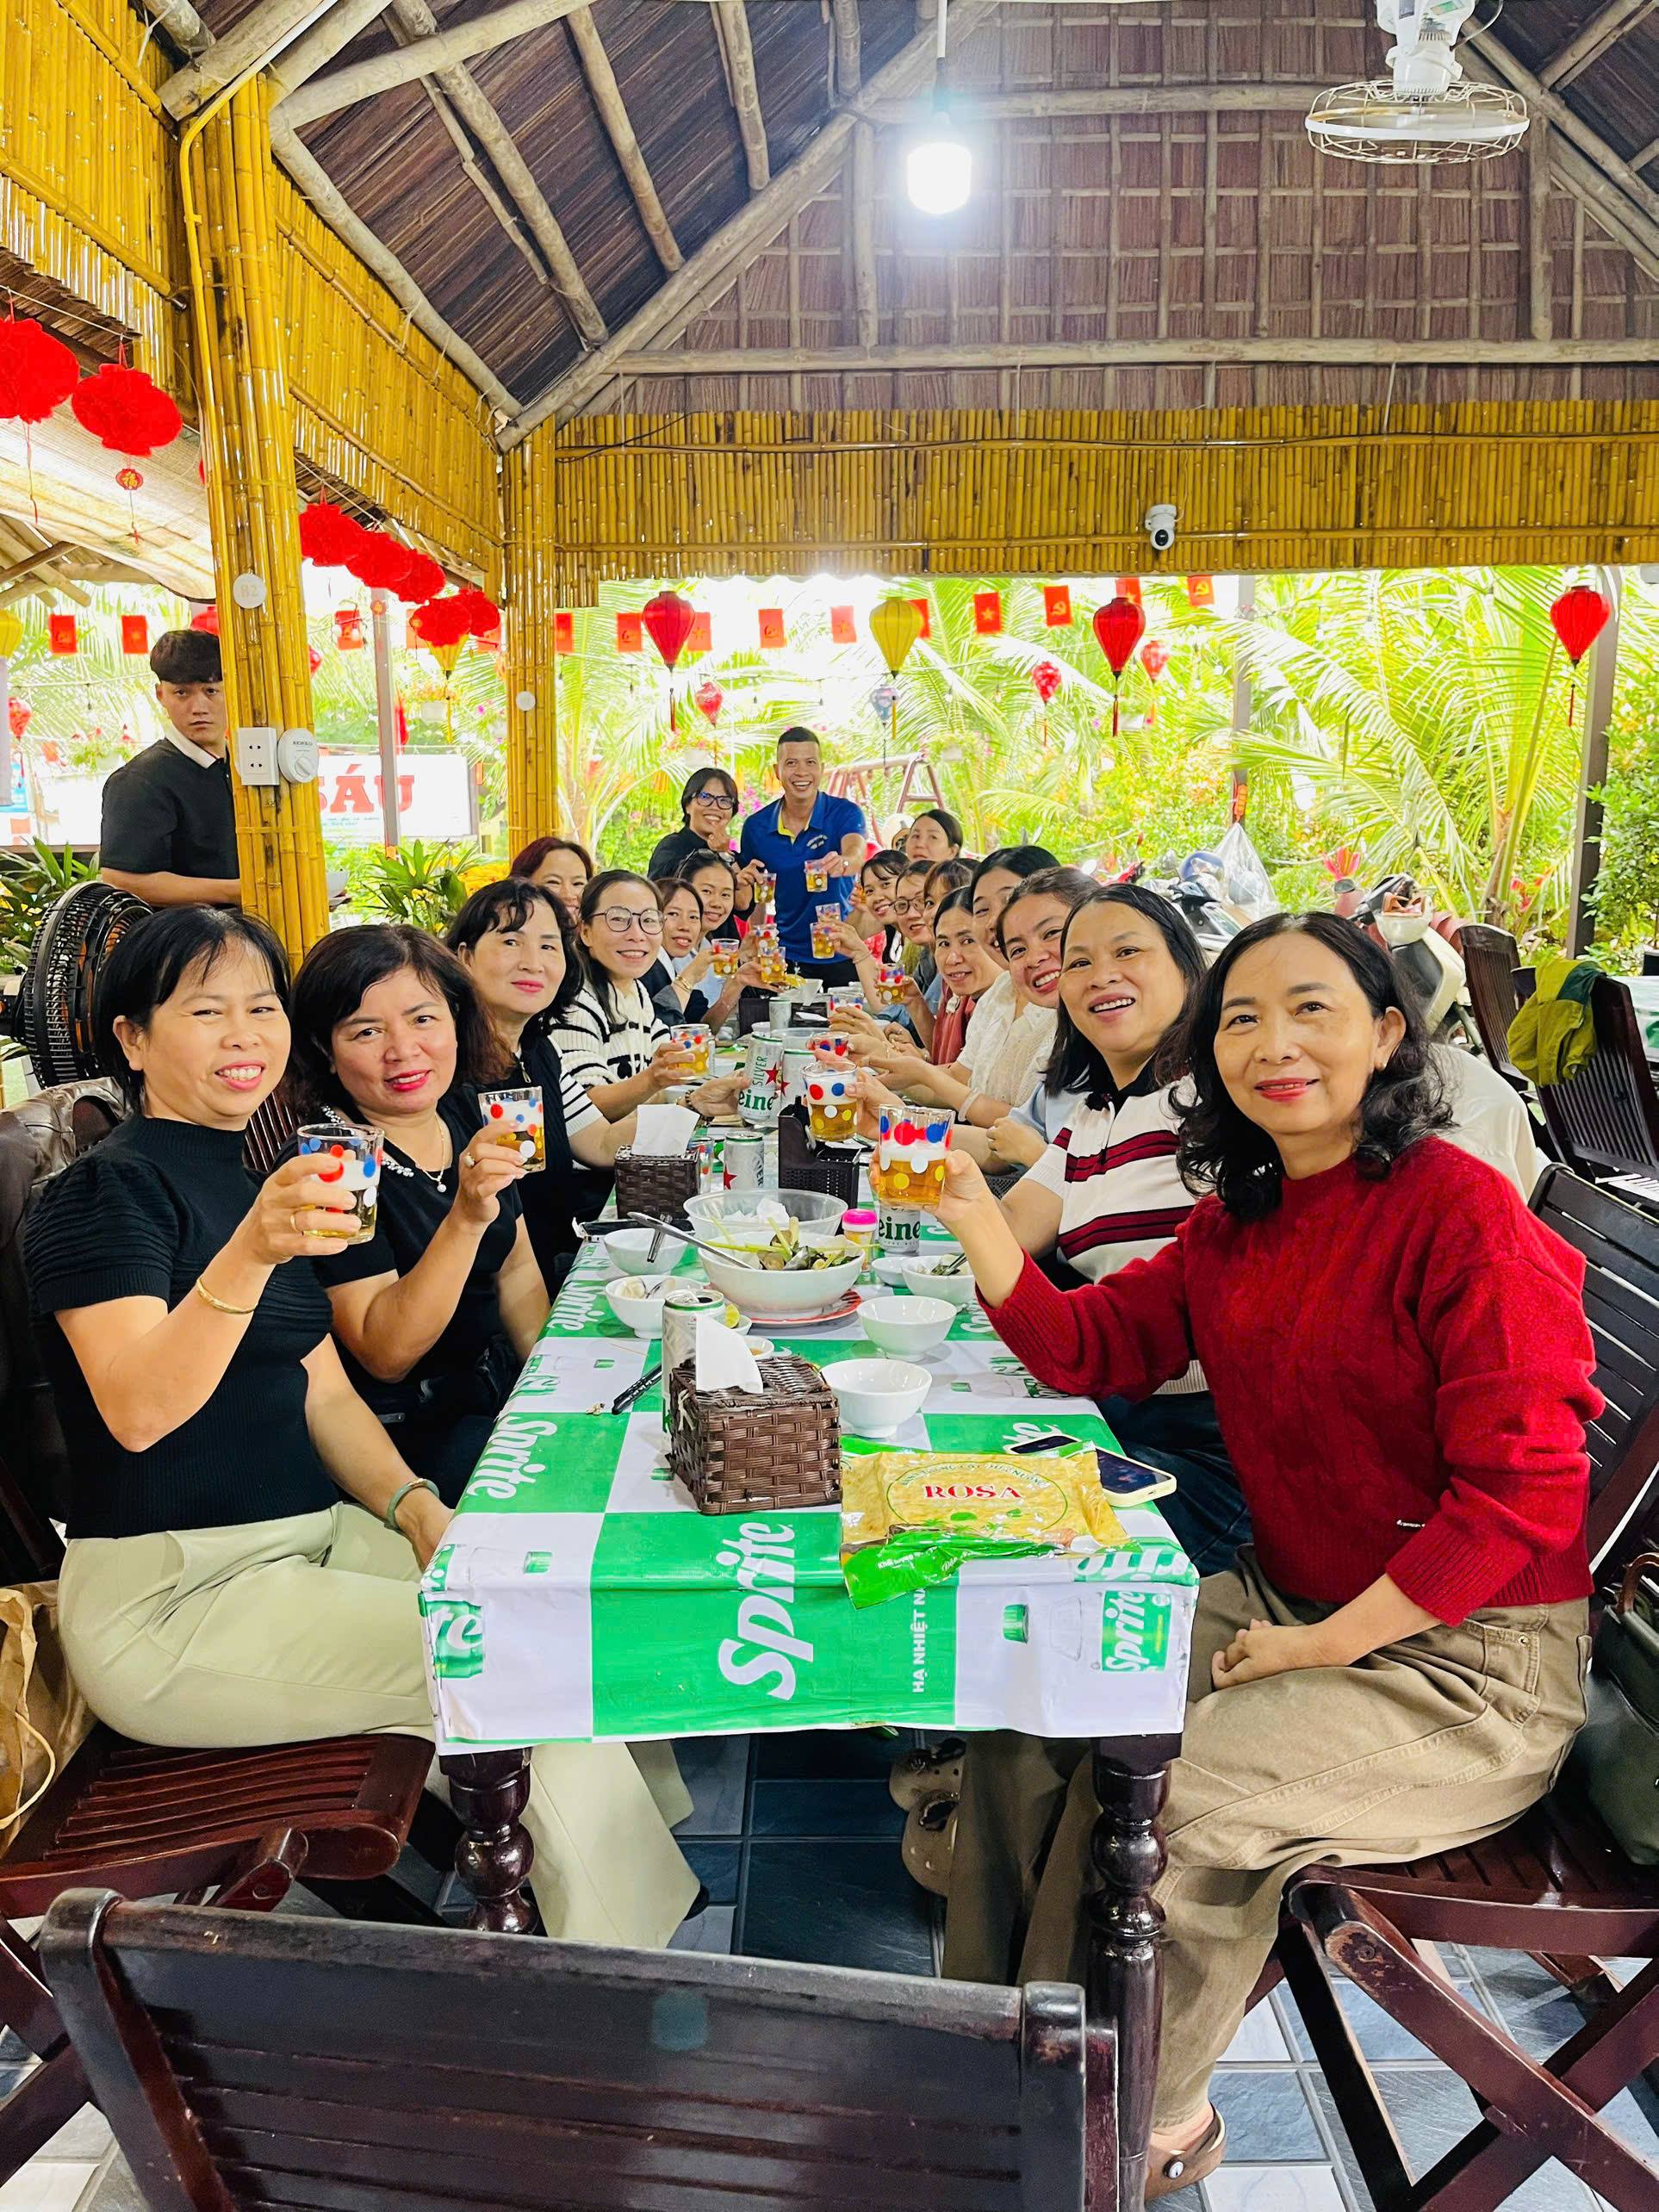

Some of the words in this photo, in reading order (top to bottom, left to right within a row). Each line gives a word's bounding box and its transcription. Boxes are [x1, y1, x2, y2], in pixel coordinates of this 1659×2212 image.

[752, 1056, 767, 1086] SILVER
[466, 1414, 558, 1500] Sprite
[924, 1484, 1022, 1500] ROSA
[716, 1522, 814, 1700] Sprite
[910, 1609, 929, 1666] NHIỆT
[1105, 1590, 1151, 1672] Sprite
[912, 1668, 929, 1693] HẠ
